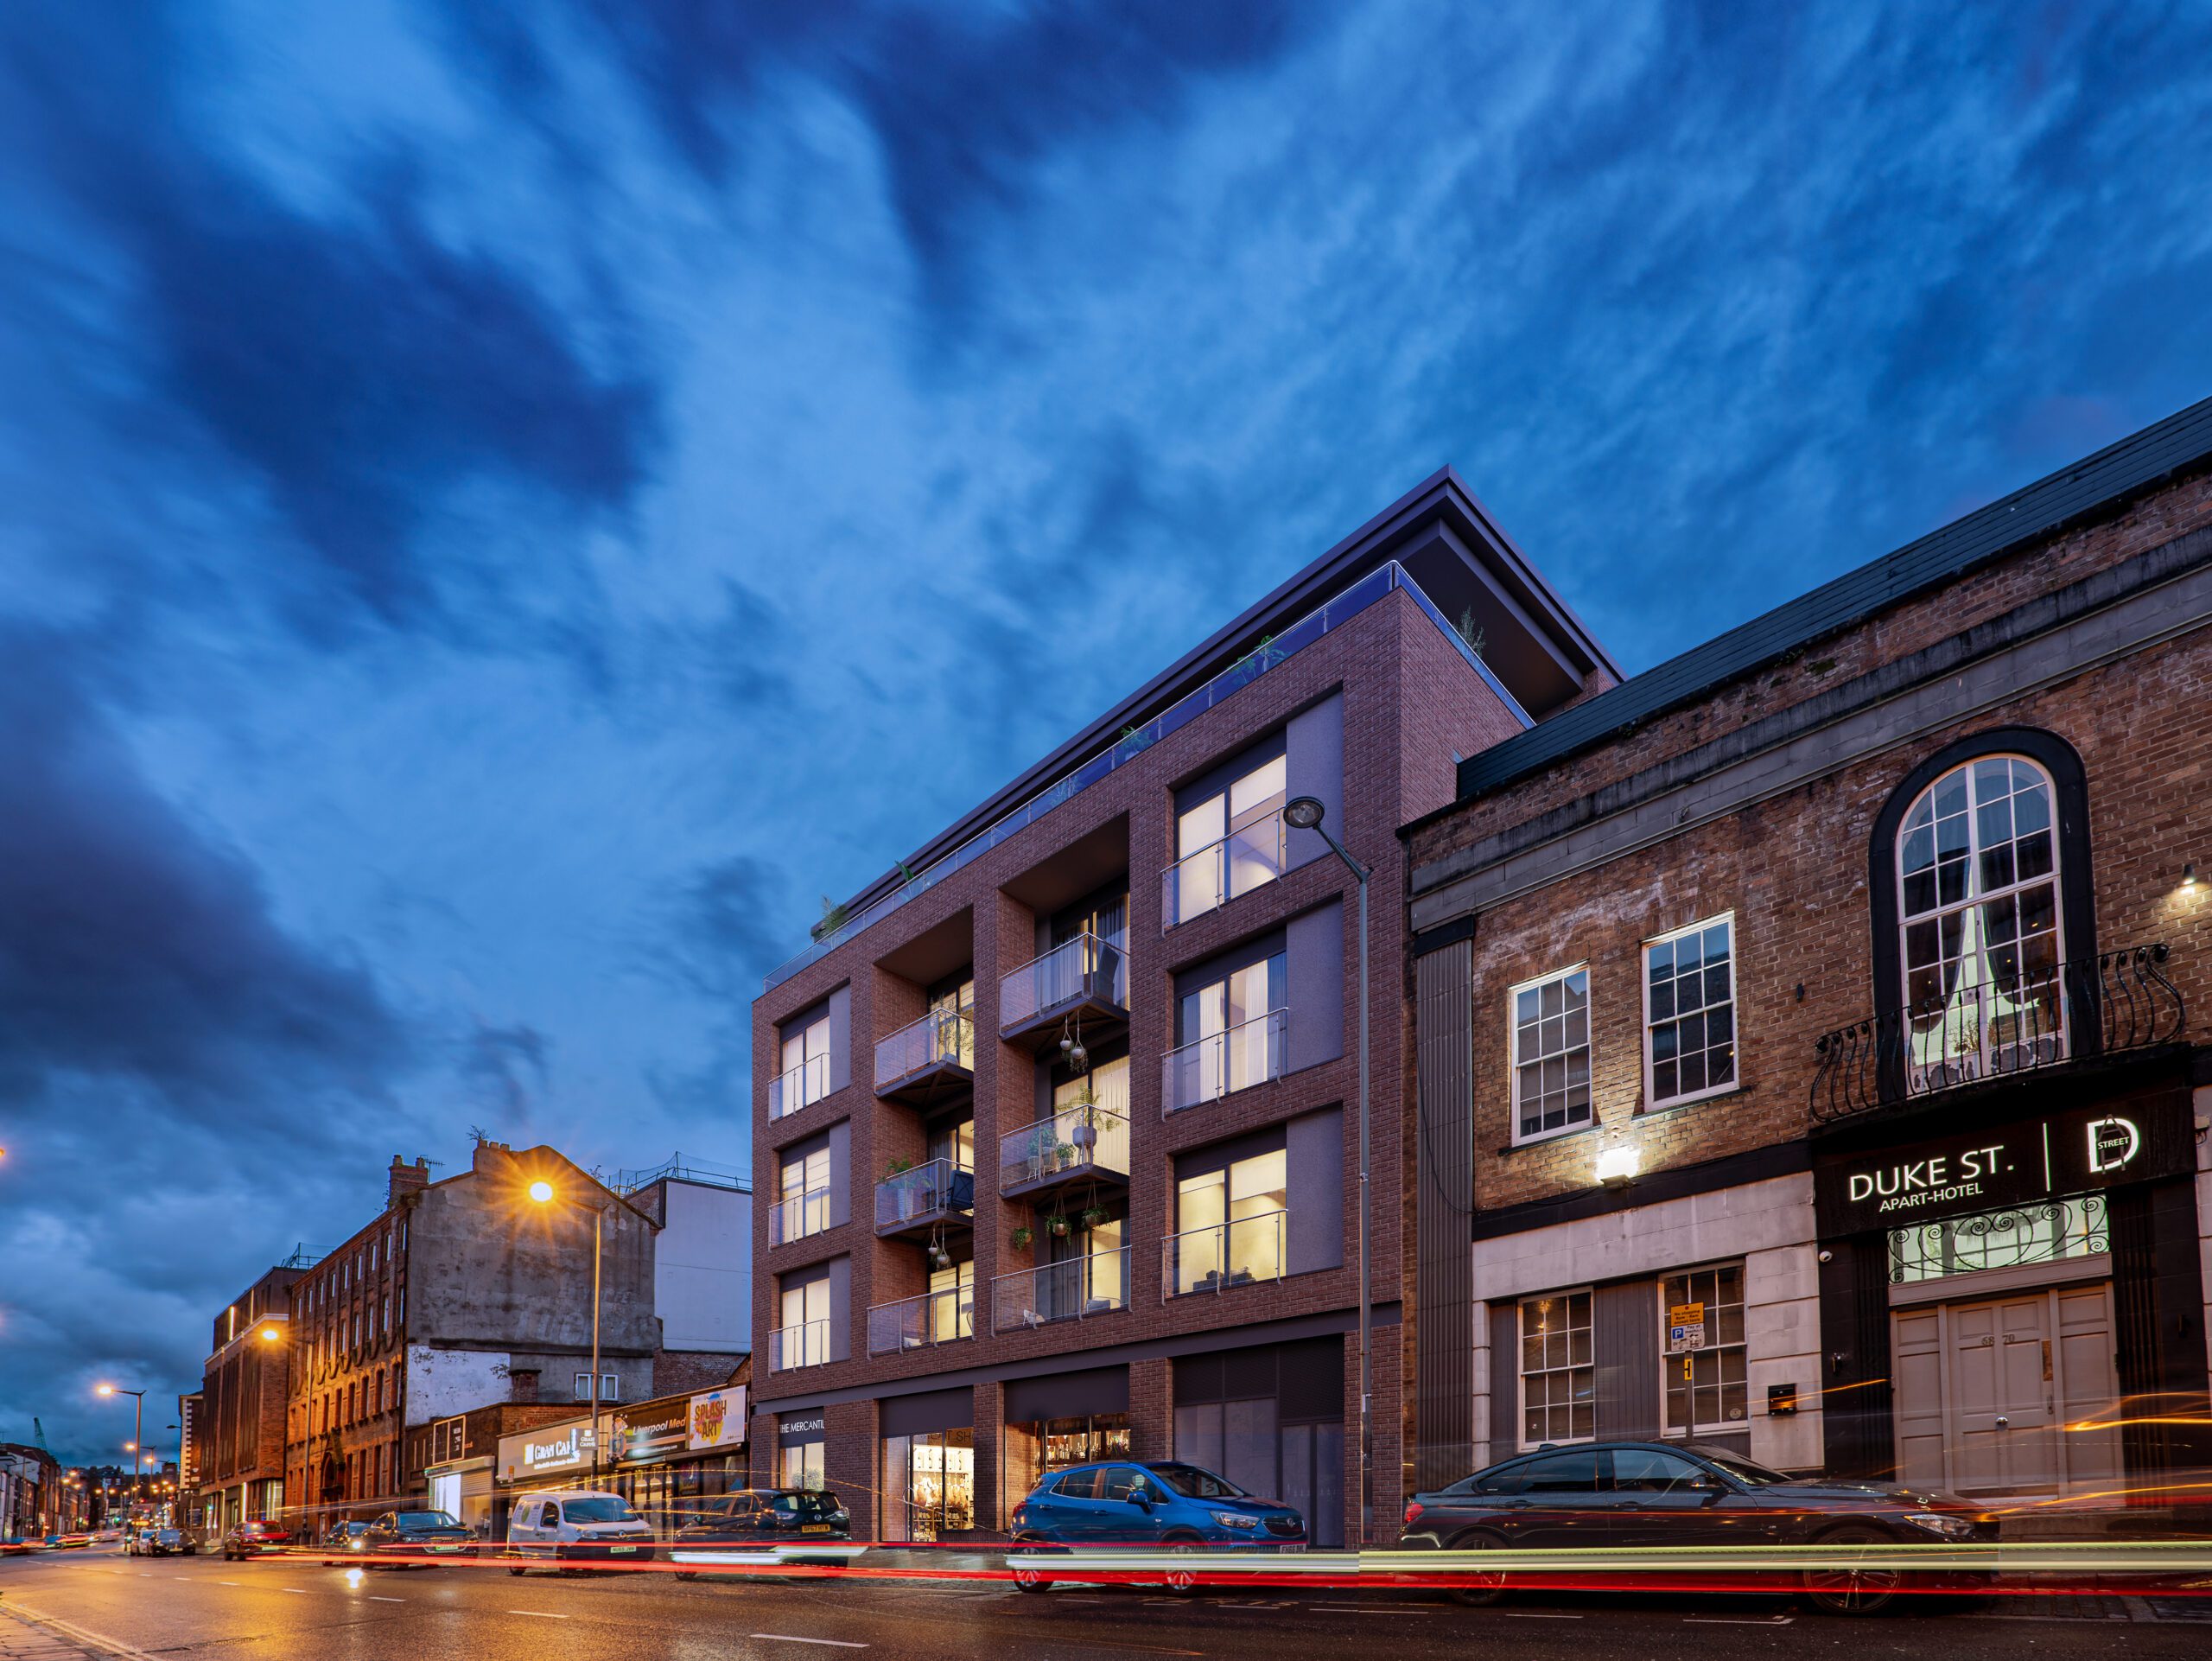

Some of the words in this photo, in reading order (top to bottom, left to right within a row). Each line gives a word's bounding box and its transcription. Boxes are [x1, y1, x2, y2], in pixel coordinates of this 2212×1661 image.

[2097, 1136, 2130, 1149] STREET
[1849, 1157, 1948, 1201] DUKE
[1960, 1145, 2014, 1180] ST.
[1878, 1182, 1984, 1212] APART-HOTEL
[1675, 1329, 1682, 1339] P
[1981, 1335, 1995, 1346] 68
[2001, 1333, 2015, 1344] 70
[695, 1399, 727, 1422] SPLASH
[632, 1420, 669, 1436] Liverpool
[702, 1419, 717, 1439] ART
